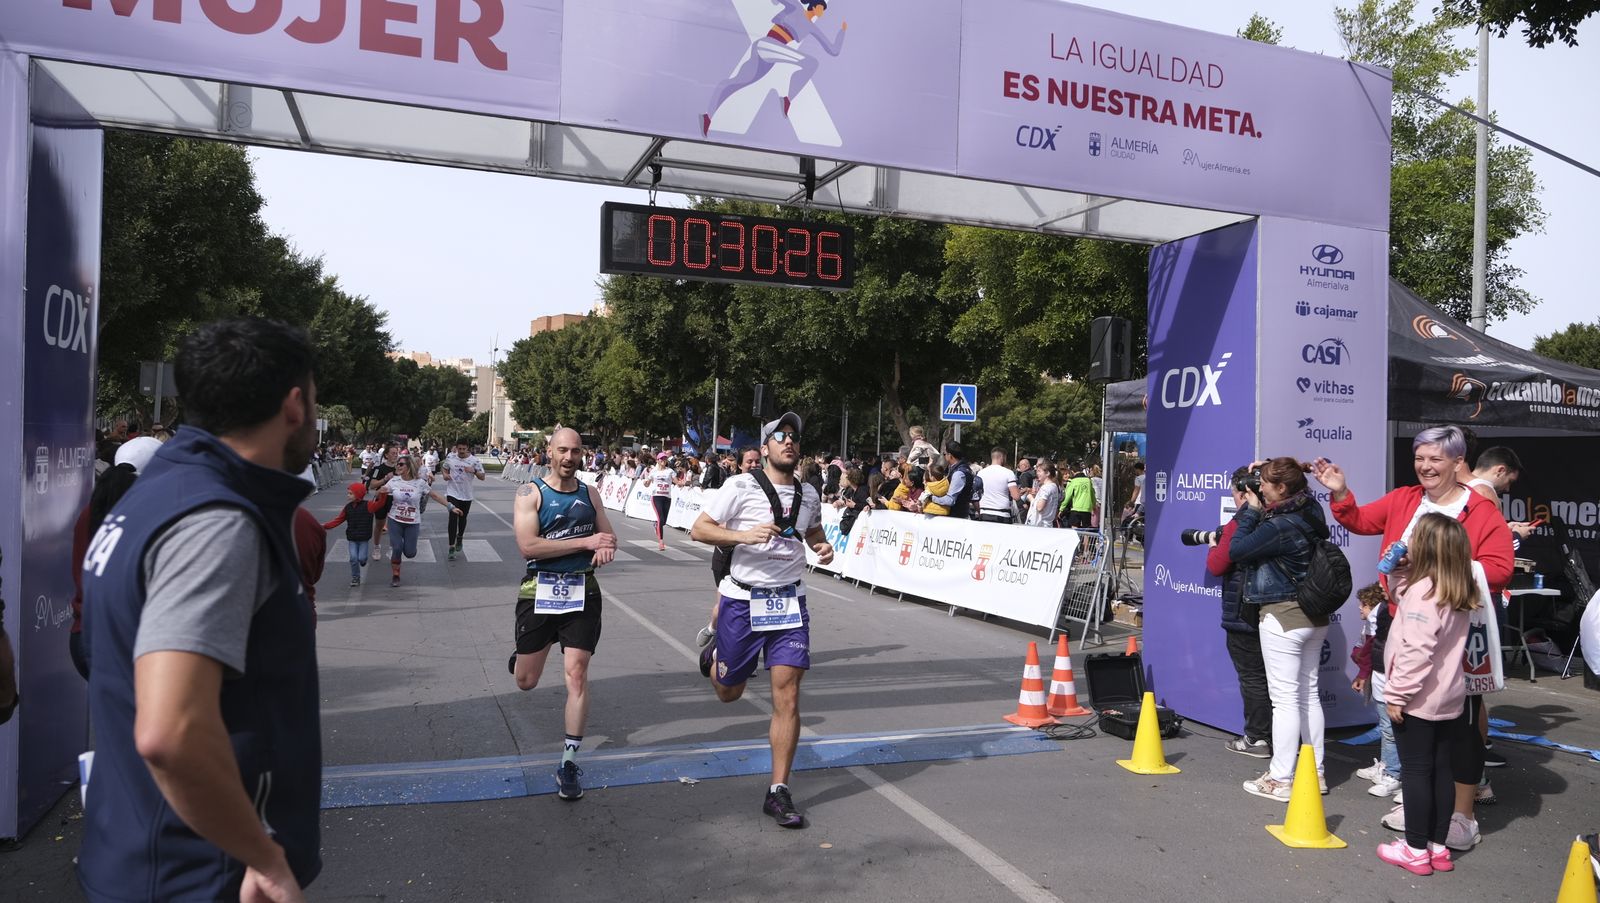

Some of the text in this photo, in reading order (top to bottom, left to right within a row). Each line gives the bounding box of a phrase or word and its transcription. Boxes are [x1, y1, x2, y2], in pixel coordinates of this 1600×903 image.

[1050, 32, 1224, 90] LA IGUALDAD
[1003, 71, 1263, 139] ES NUESTRA META.
[1016, 125, 1062, 152] CDX
[1111, 136, 1159, 155] ALMERÍA
[1110, 149, 1136, 161] CIUDAD
[648, 214, 842, 280] 00:30:26
[1300, 265, 1355, 281] HYUNDAI
[43, 284, 93, 354] CDX
[1313, 305, 1358, 319] cajamar
[1302, 344, 1341, 365] CASI
[1161, 352, 1233, 409] CDX
[1314, 380, 1354, 395] vithas
[1305, 426, 1352, 443] aqualia
[1176, 490, 1206, 501] CIUDAD
[921, 536, 973, 561] ALMERÍA
[918, 555, 945, 571] CIUDAD
[998, 548, 1063, 574] ALMERÍA
[997, 568, 1029, 586] CIUDAD
[552, 585, 569, 596] 65
[765, 598, 784, 610] 96
